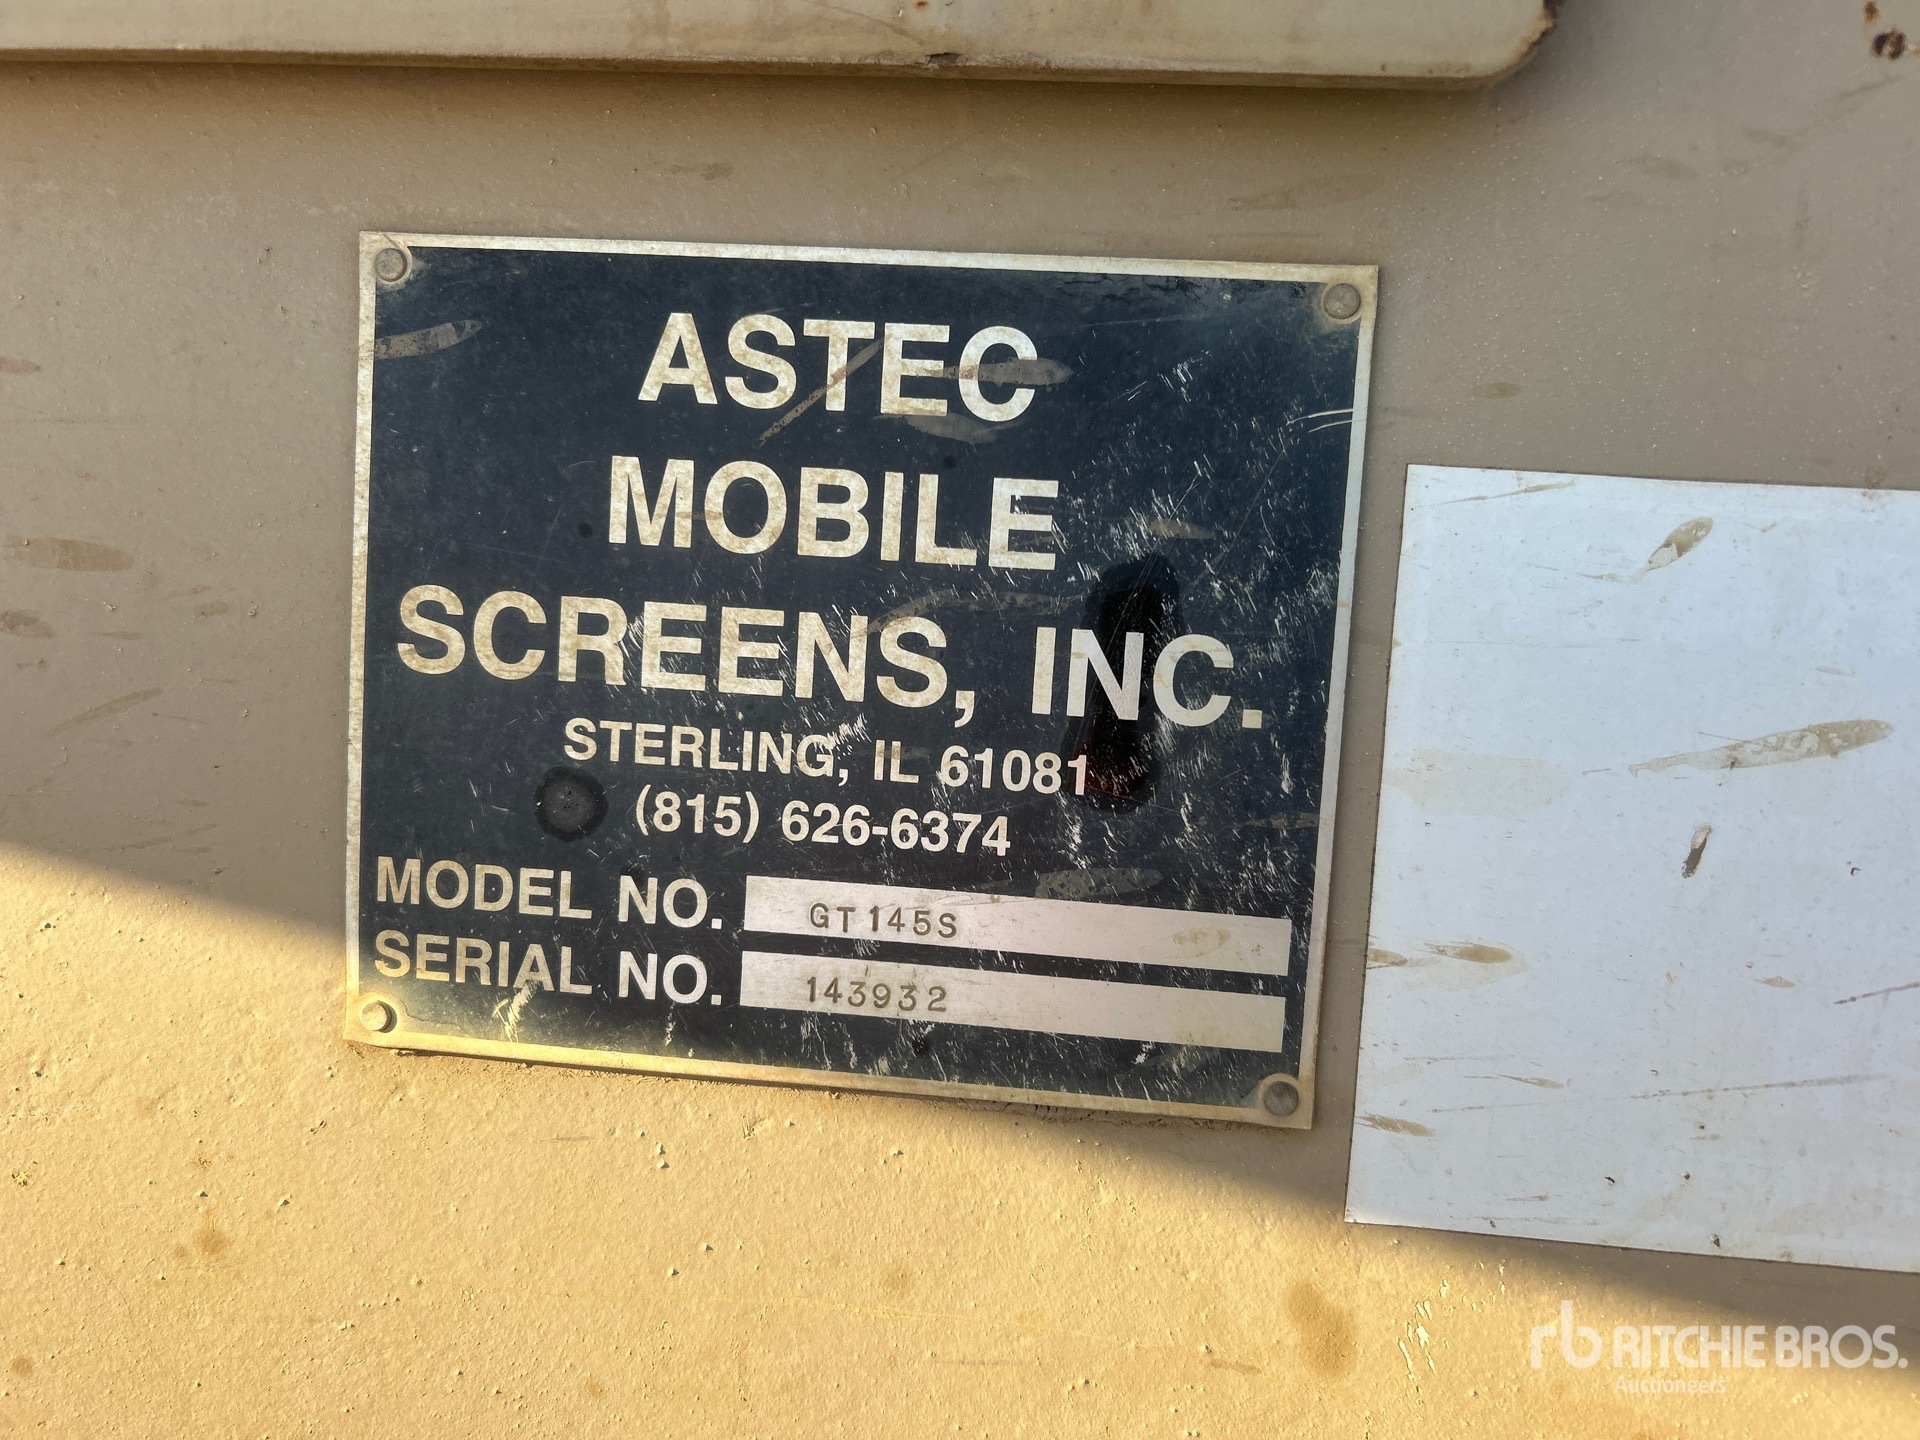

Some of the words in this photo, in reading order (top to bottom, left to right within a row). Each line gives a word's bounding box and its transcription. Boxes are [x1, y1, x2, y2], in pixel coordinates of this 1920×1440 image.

[637, 312, 1039, 423] ASTEC
[608, 455, 1060, 572] MOBILE
[396, 584, 976, 730] SCREENS,
[1030, 625, 1264, 731] INC.
[563, 718, 850, 788] STERLING,
[873, 744, 920, 786] IL
[937, 745, 1091, 797] 61081
[634, 786, 761, 845] (815)
[780, 801, 1012, 857] 626-6374
[375, 855, 593, 920] MODEL
[618, 875, 724, 930] NO.
[808, 901, 960, 941] GT145S
[374, 929, 593, 996] SERIAL
[618, 951, 724, 1007] NO.
[804, 973, 949, 1014] 143932
